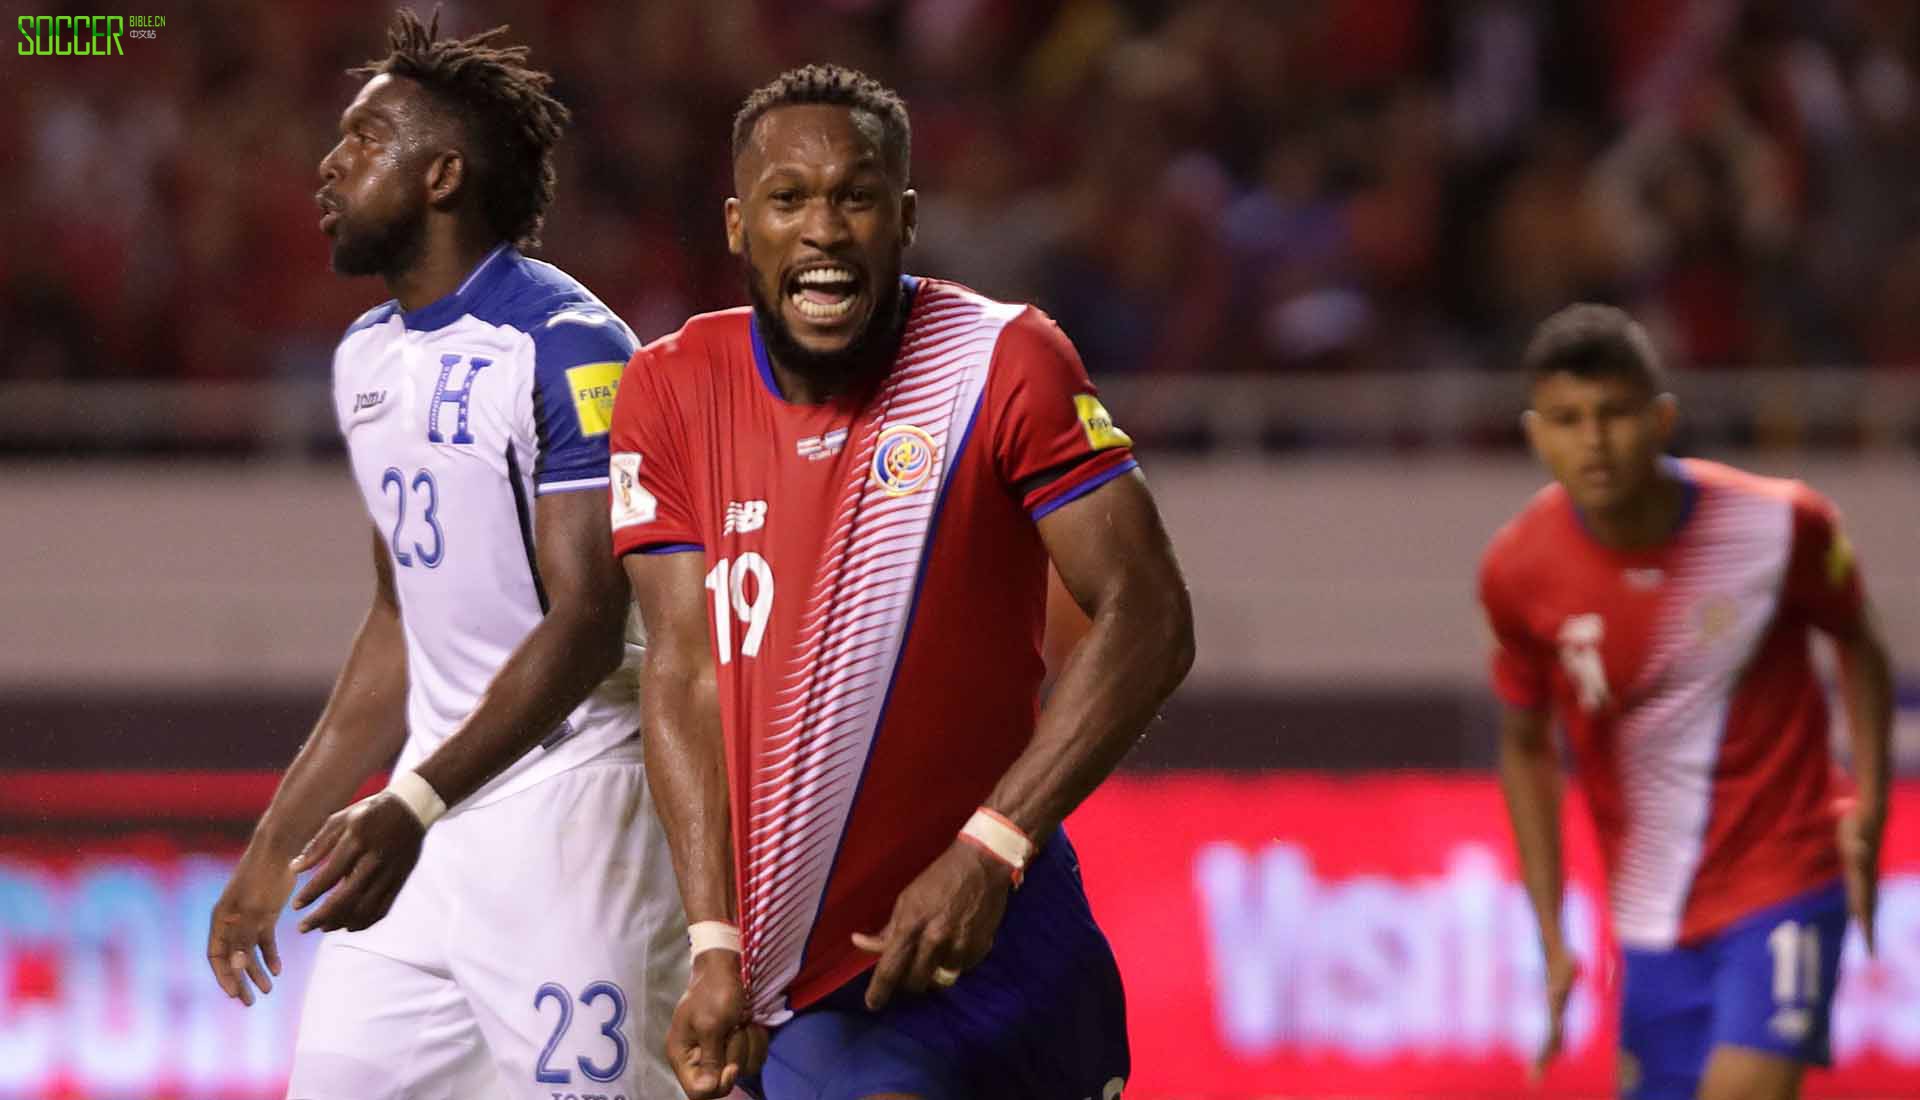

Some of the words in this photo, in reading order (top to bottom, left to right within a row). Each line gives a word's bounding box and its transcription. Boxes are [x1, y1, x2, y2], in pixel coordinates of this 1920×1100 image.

[578, 384, 612, 401] FIFA
[382, 467, 445, 569] 23
[704, 551, 775, 666] 19
[1768, 920, 1821, 1004] 11
[533, 979, 629, 1084] 23
